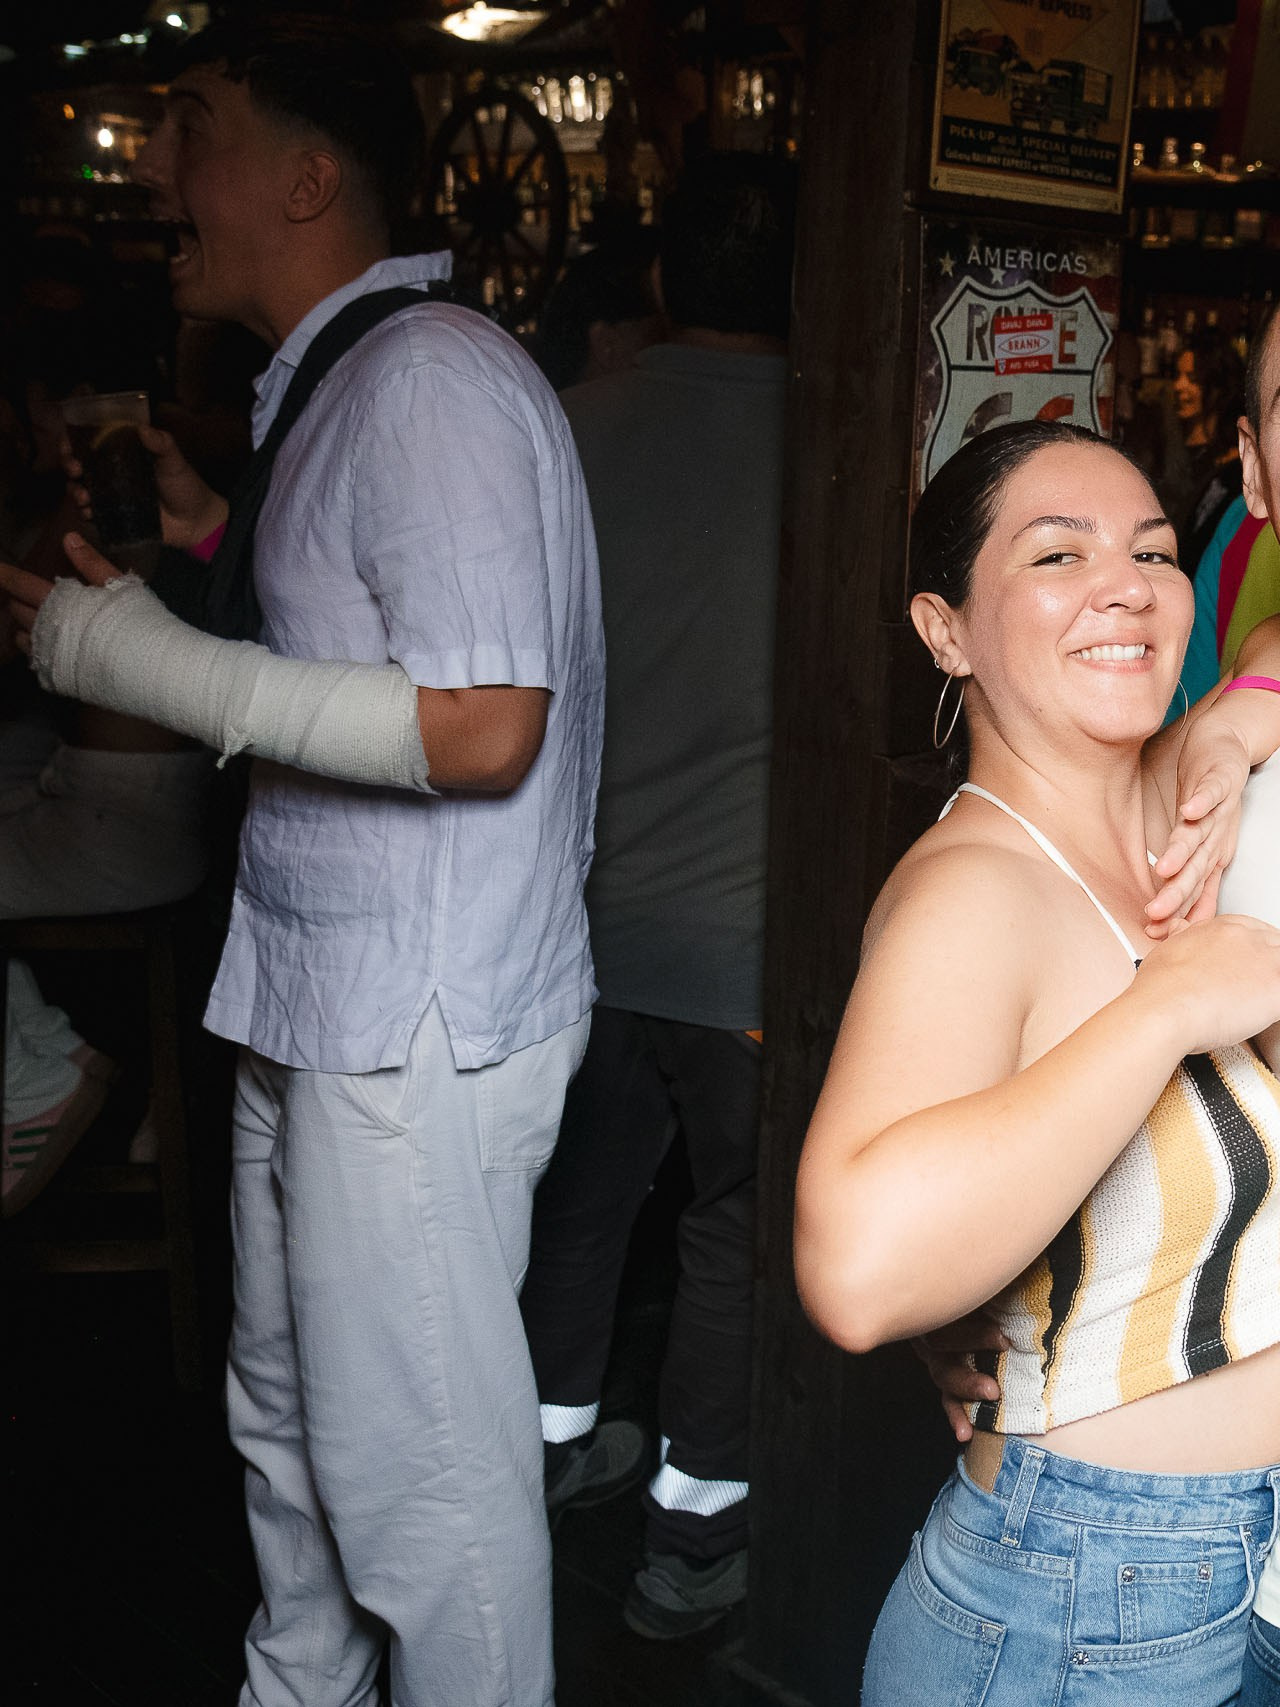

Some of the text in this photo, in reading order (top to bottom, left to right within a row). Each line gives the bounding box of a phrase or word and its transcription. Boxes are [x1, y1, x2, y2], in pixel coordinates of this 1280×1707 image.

[1039, 0, 1093, 21] EXPRESS
[1022, 137, 1066, 154] SPECIAL
[1069, 146, 1118, 162] DELIVERY
[1002, 156, 1032, 171] EXPRESS
[967, 245, 1088, 274] AMERICA'S
[1008, 338, 1041, 351] BRANN
